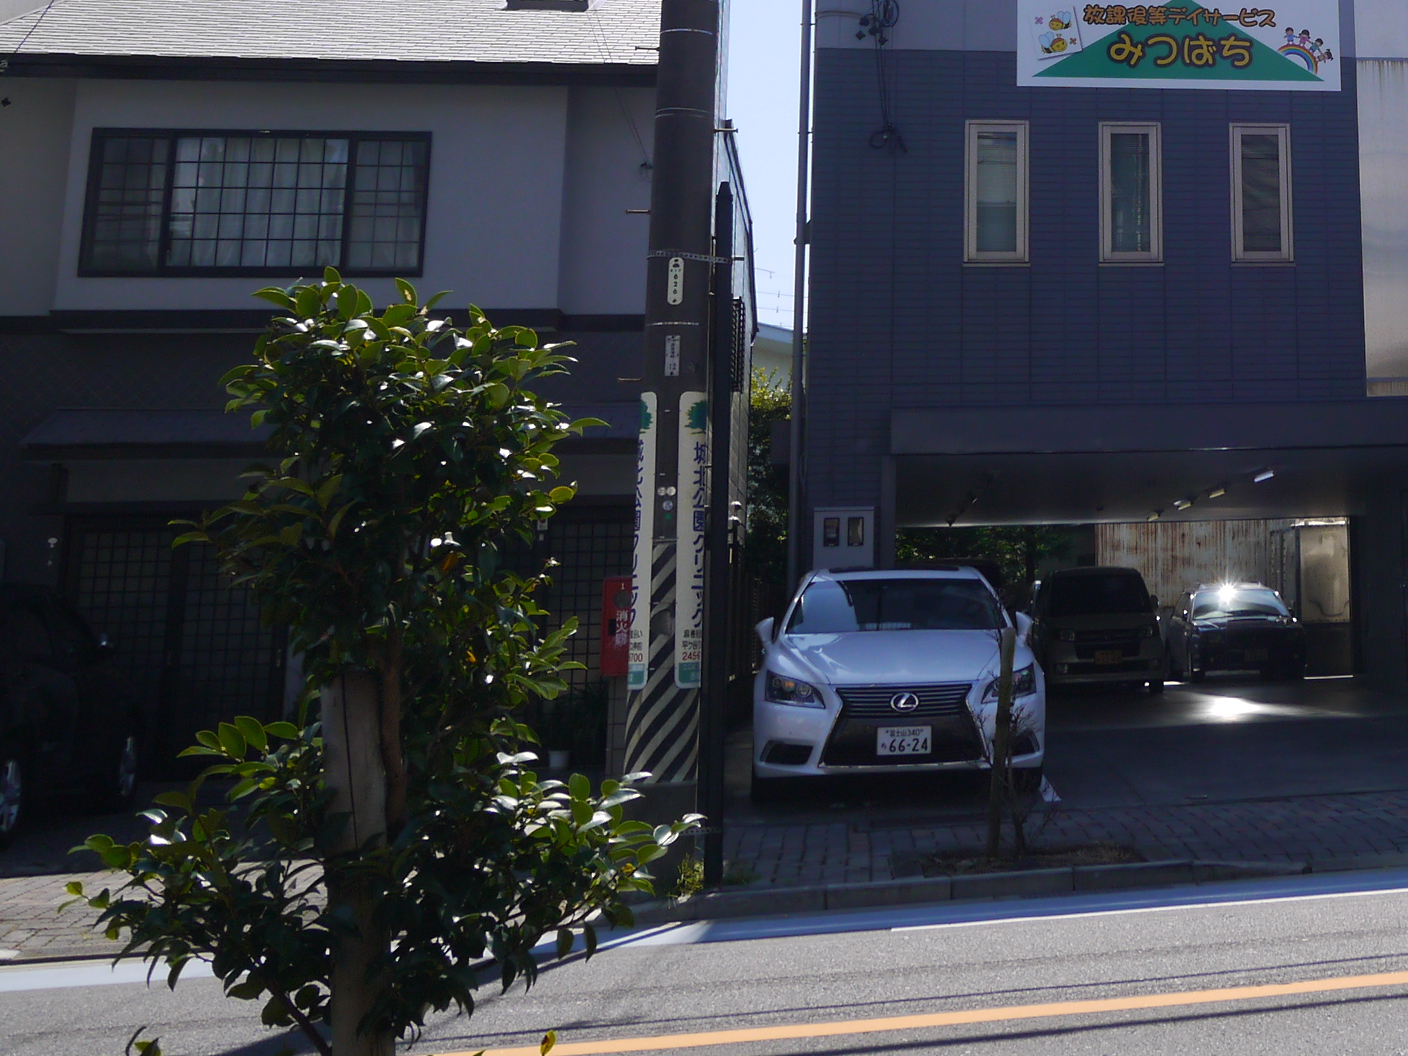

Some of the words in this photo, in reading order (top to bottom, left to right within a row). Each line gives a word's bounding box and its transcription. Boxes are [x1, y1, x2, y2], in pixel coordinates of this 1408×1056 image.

[1083, 4, 1277, 28] 放課後等デイサービス
[1107, 31, 1255, 70] みつばち
[889, 737, 929, 753] 66-24
